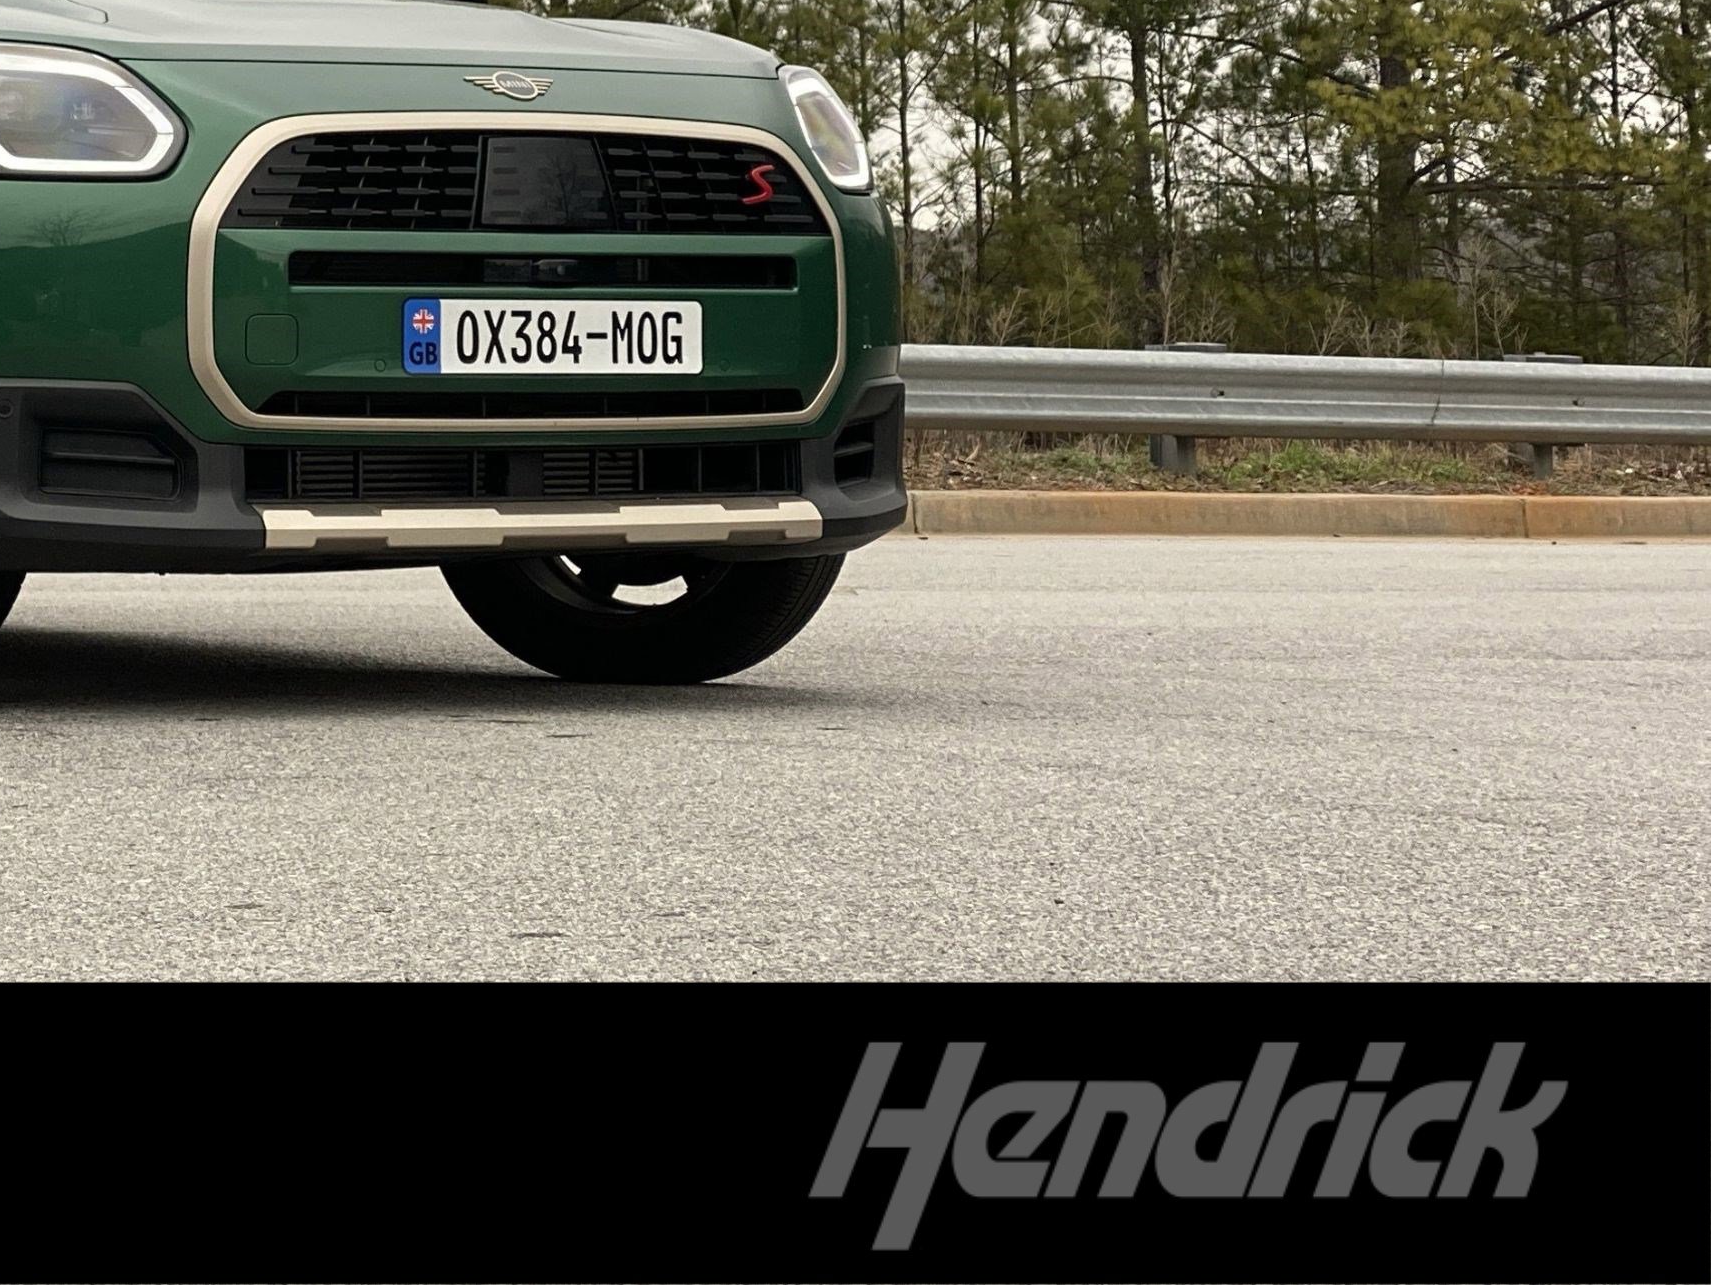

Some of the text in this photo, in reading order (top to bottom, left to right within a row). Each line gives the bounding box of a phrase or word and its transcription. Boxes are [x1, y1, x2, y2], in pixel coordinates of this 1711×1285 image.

[498, 79, 532, 89] MINI
[742, 164, 776, 205] S
[408, 341, 438, 365] GB
[456, 309, 684, 365] OX384-MOG
